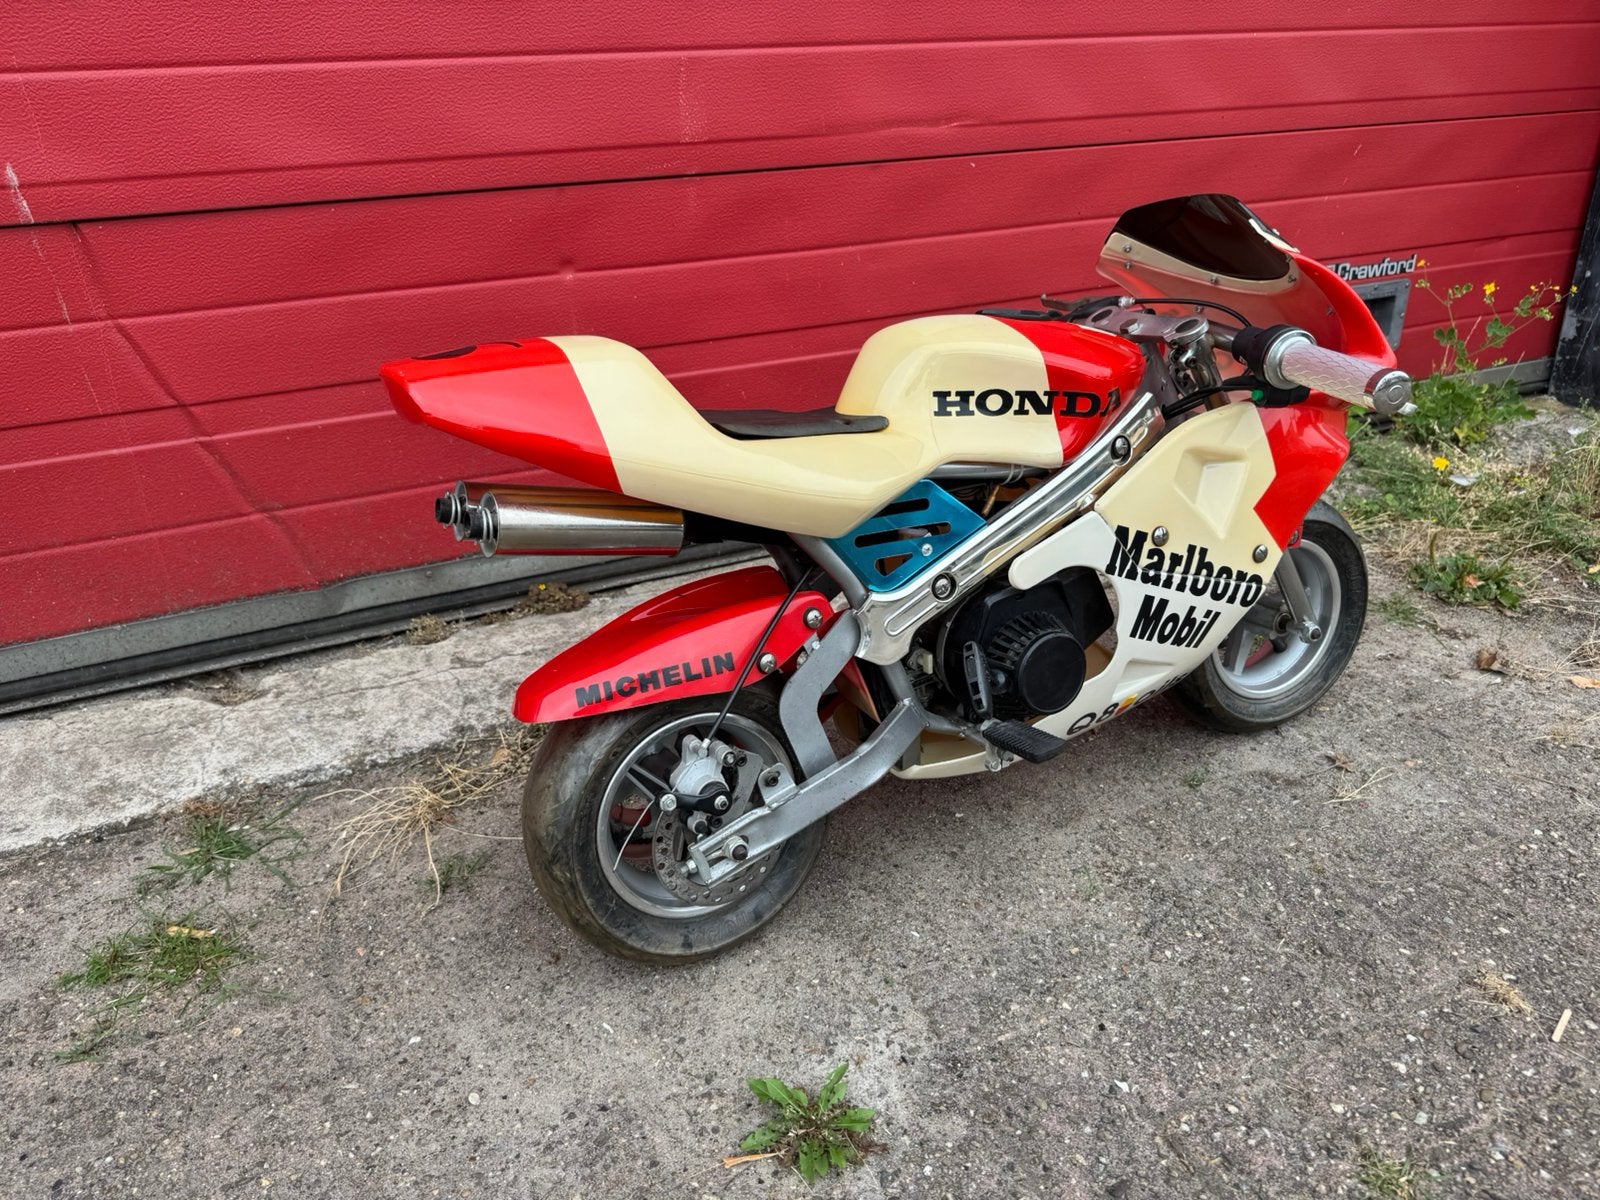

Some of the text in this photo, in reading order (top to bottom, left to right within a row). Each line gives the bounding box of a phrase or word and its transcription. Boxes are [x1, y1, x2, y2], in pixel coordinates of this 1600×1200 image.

[1337, 253, 1418, 281] Crawford
[932, 387, 1122, 418] HONDA
[1105, 524, 1264, 608] Marlboro
[1129, 594, 1222, 649] Mobil
[575, 652, 735, 708] MICHELIN
[1066, 702, 1120, 736] Q8
